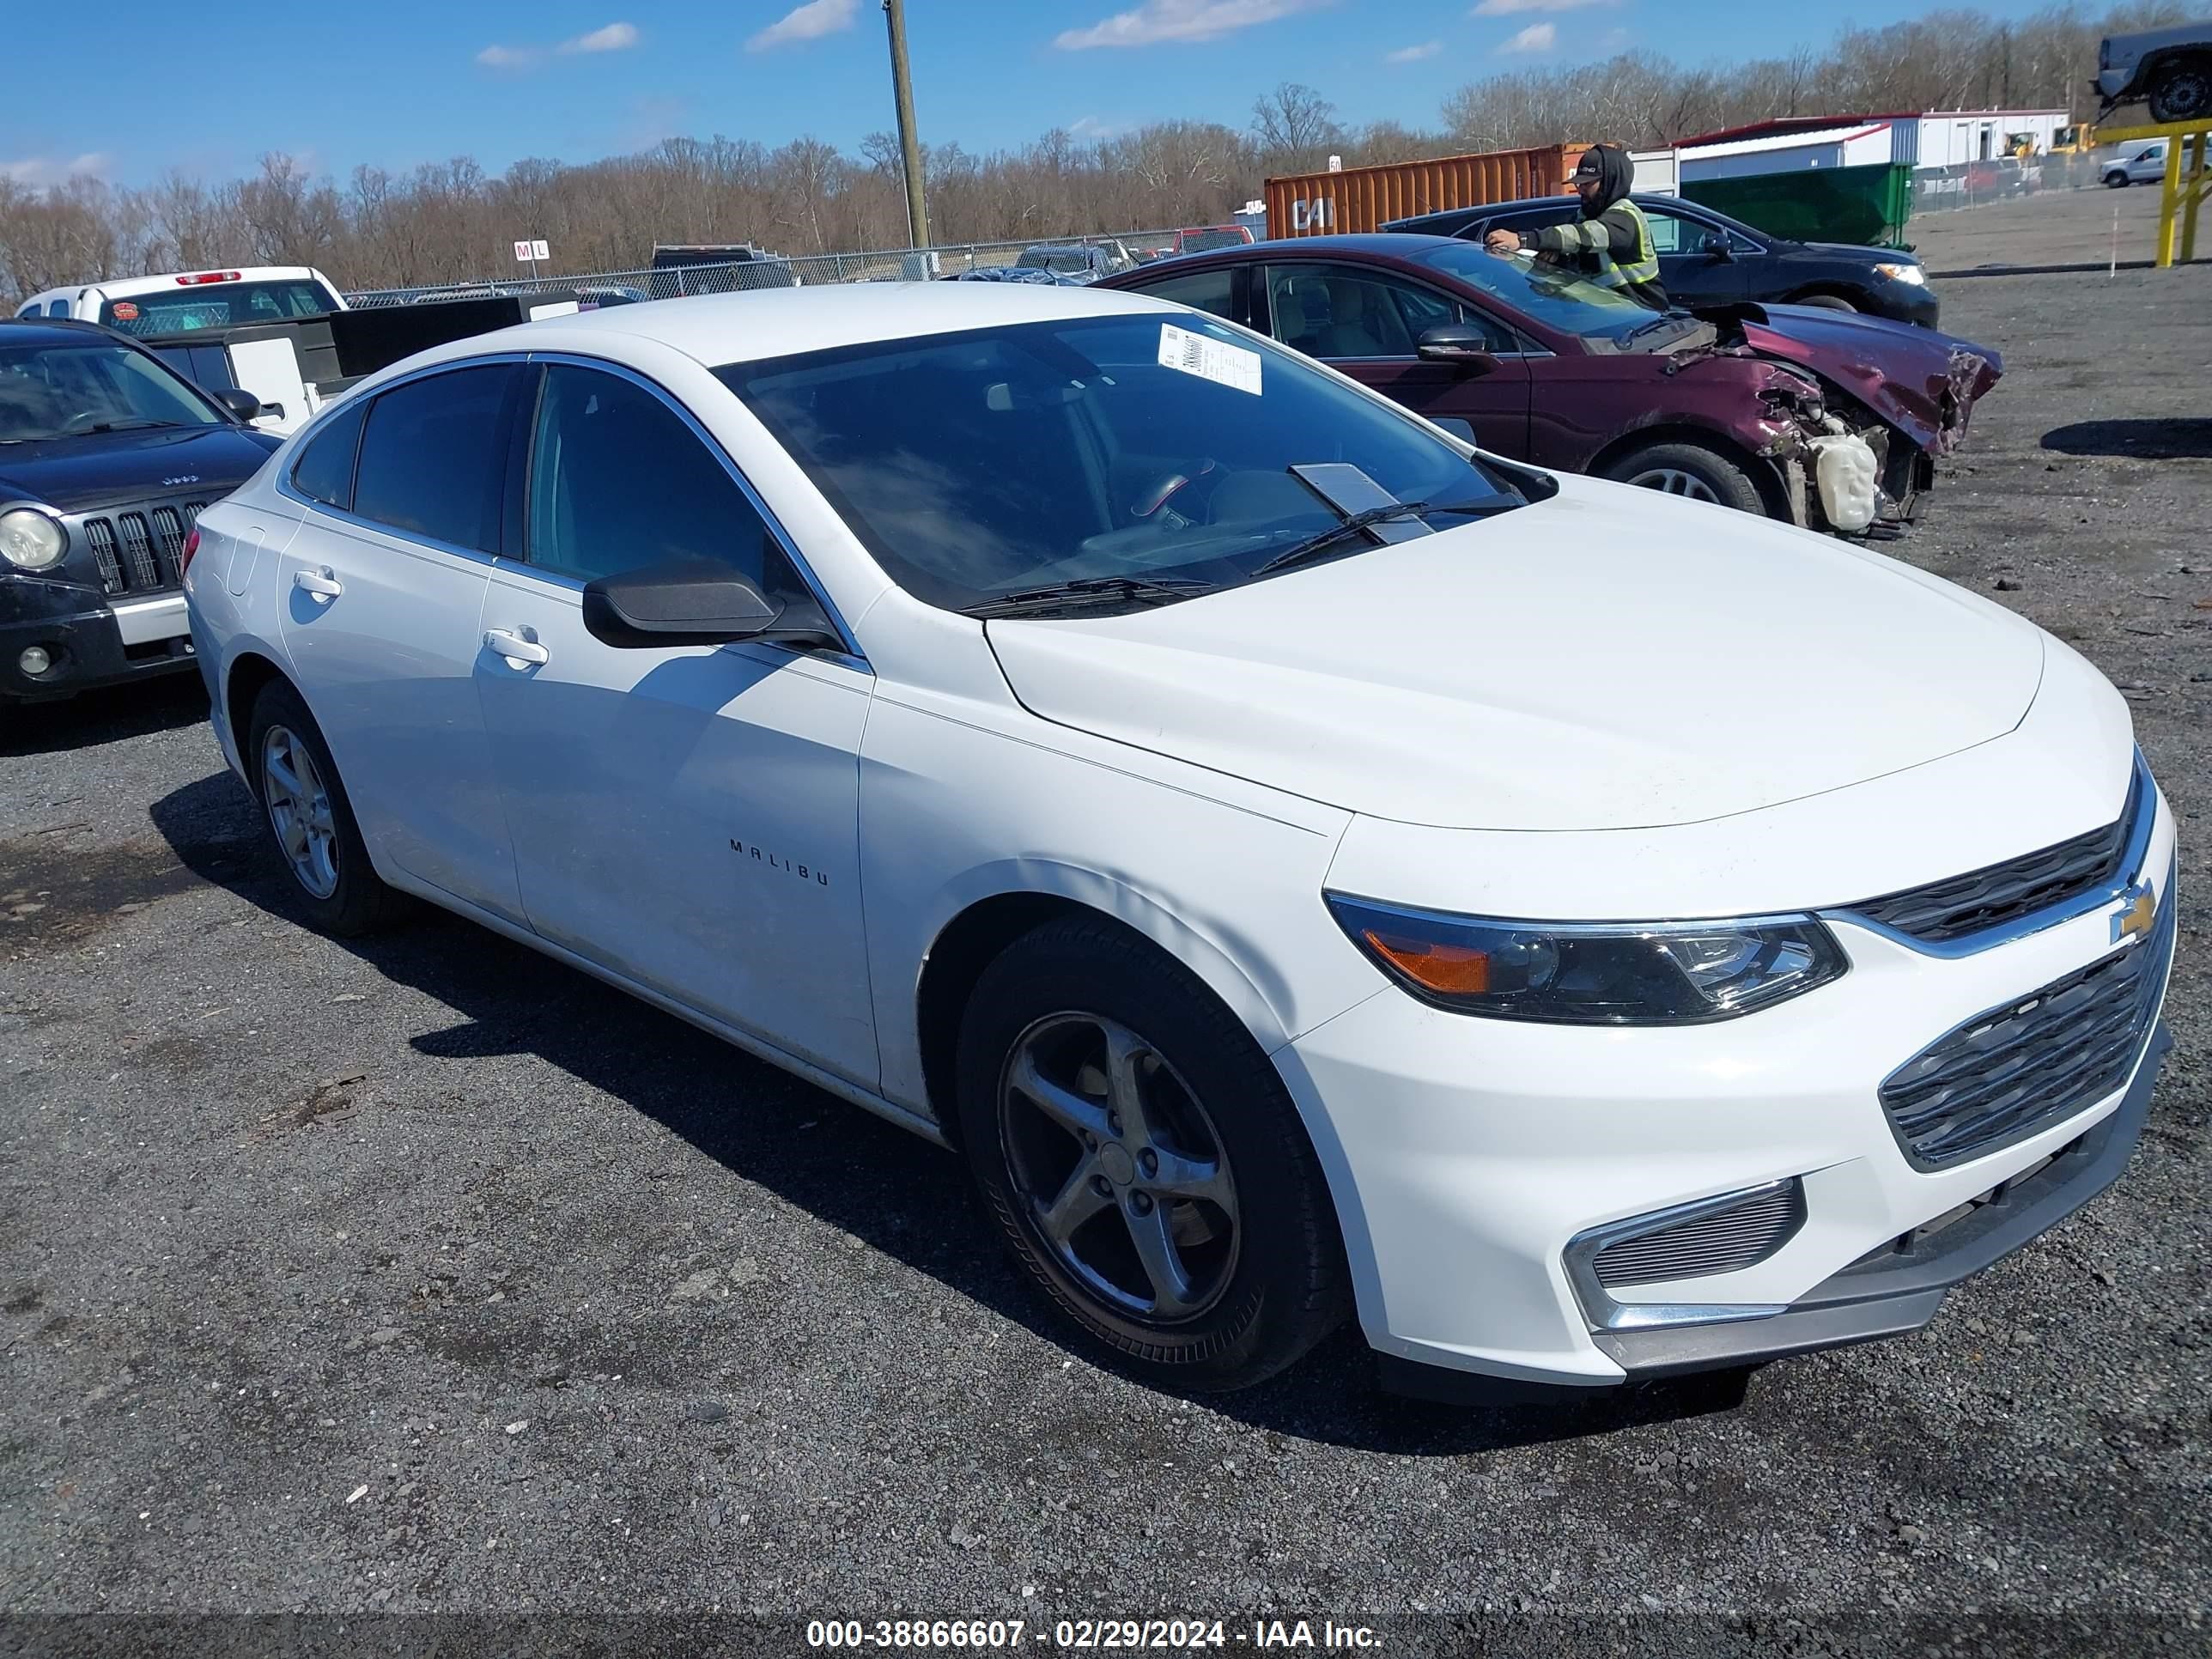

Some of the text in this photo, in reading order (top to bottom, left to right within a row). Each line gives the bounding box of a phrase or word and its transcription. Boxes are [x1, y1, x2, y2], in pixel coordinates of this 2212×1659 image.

[516, 243, 545, 258] M L
[730, 838, 828, 886] MALIBU
